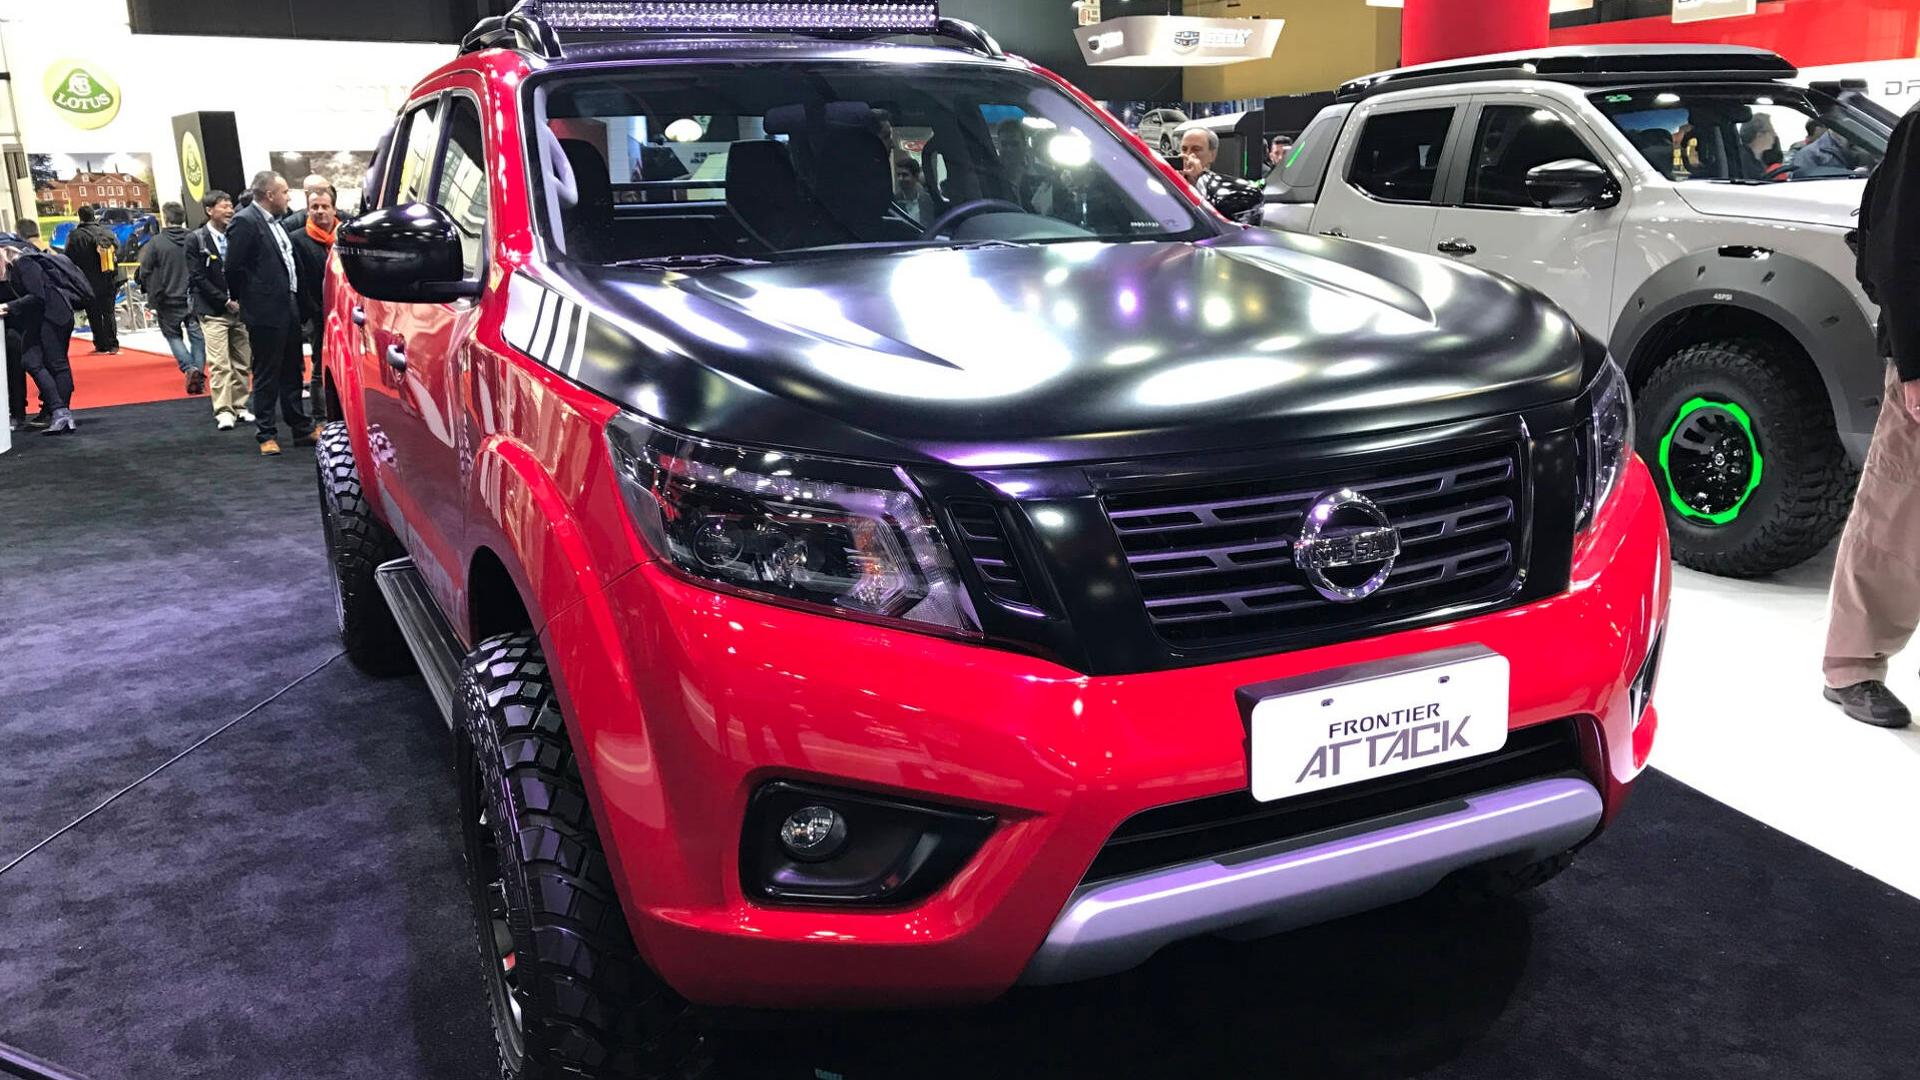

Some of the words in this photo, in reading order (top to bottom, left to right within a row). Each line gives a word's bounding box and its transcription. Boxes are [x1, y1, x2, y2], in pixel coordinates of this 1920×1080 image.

[56, 92, 111, 109] LOTUS
[1329, 703, 1440, 739] FRONTIER
[1295, 715, 1471, 783] ATTACK
